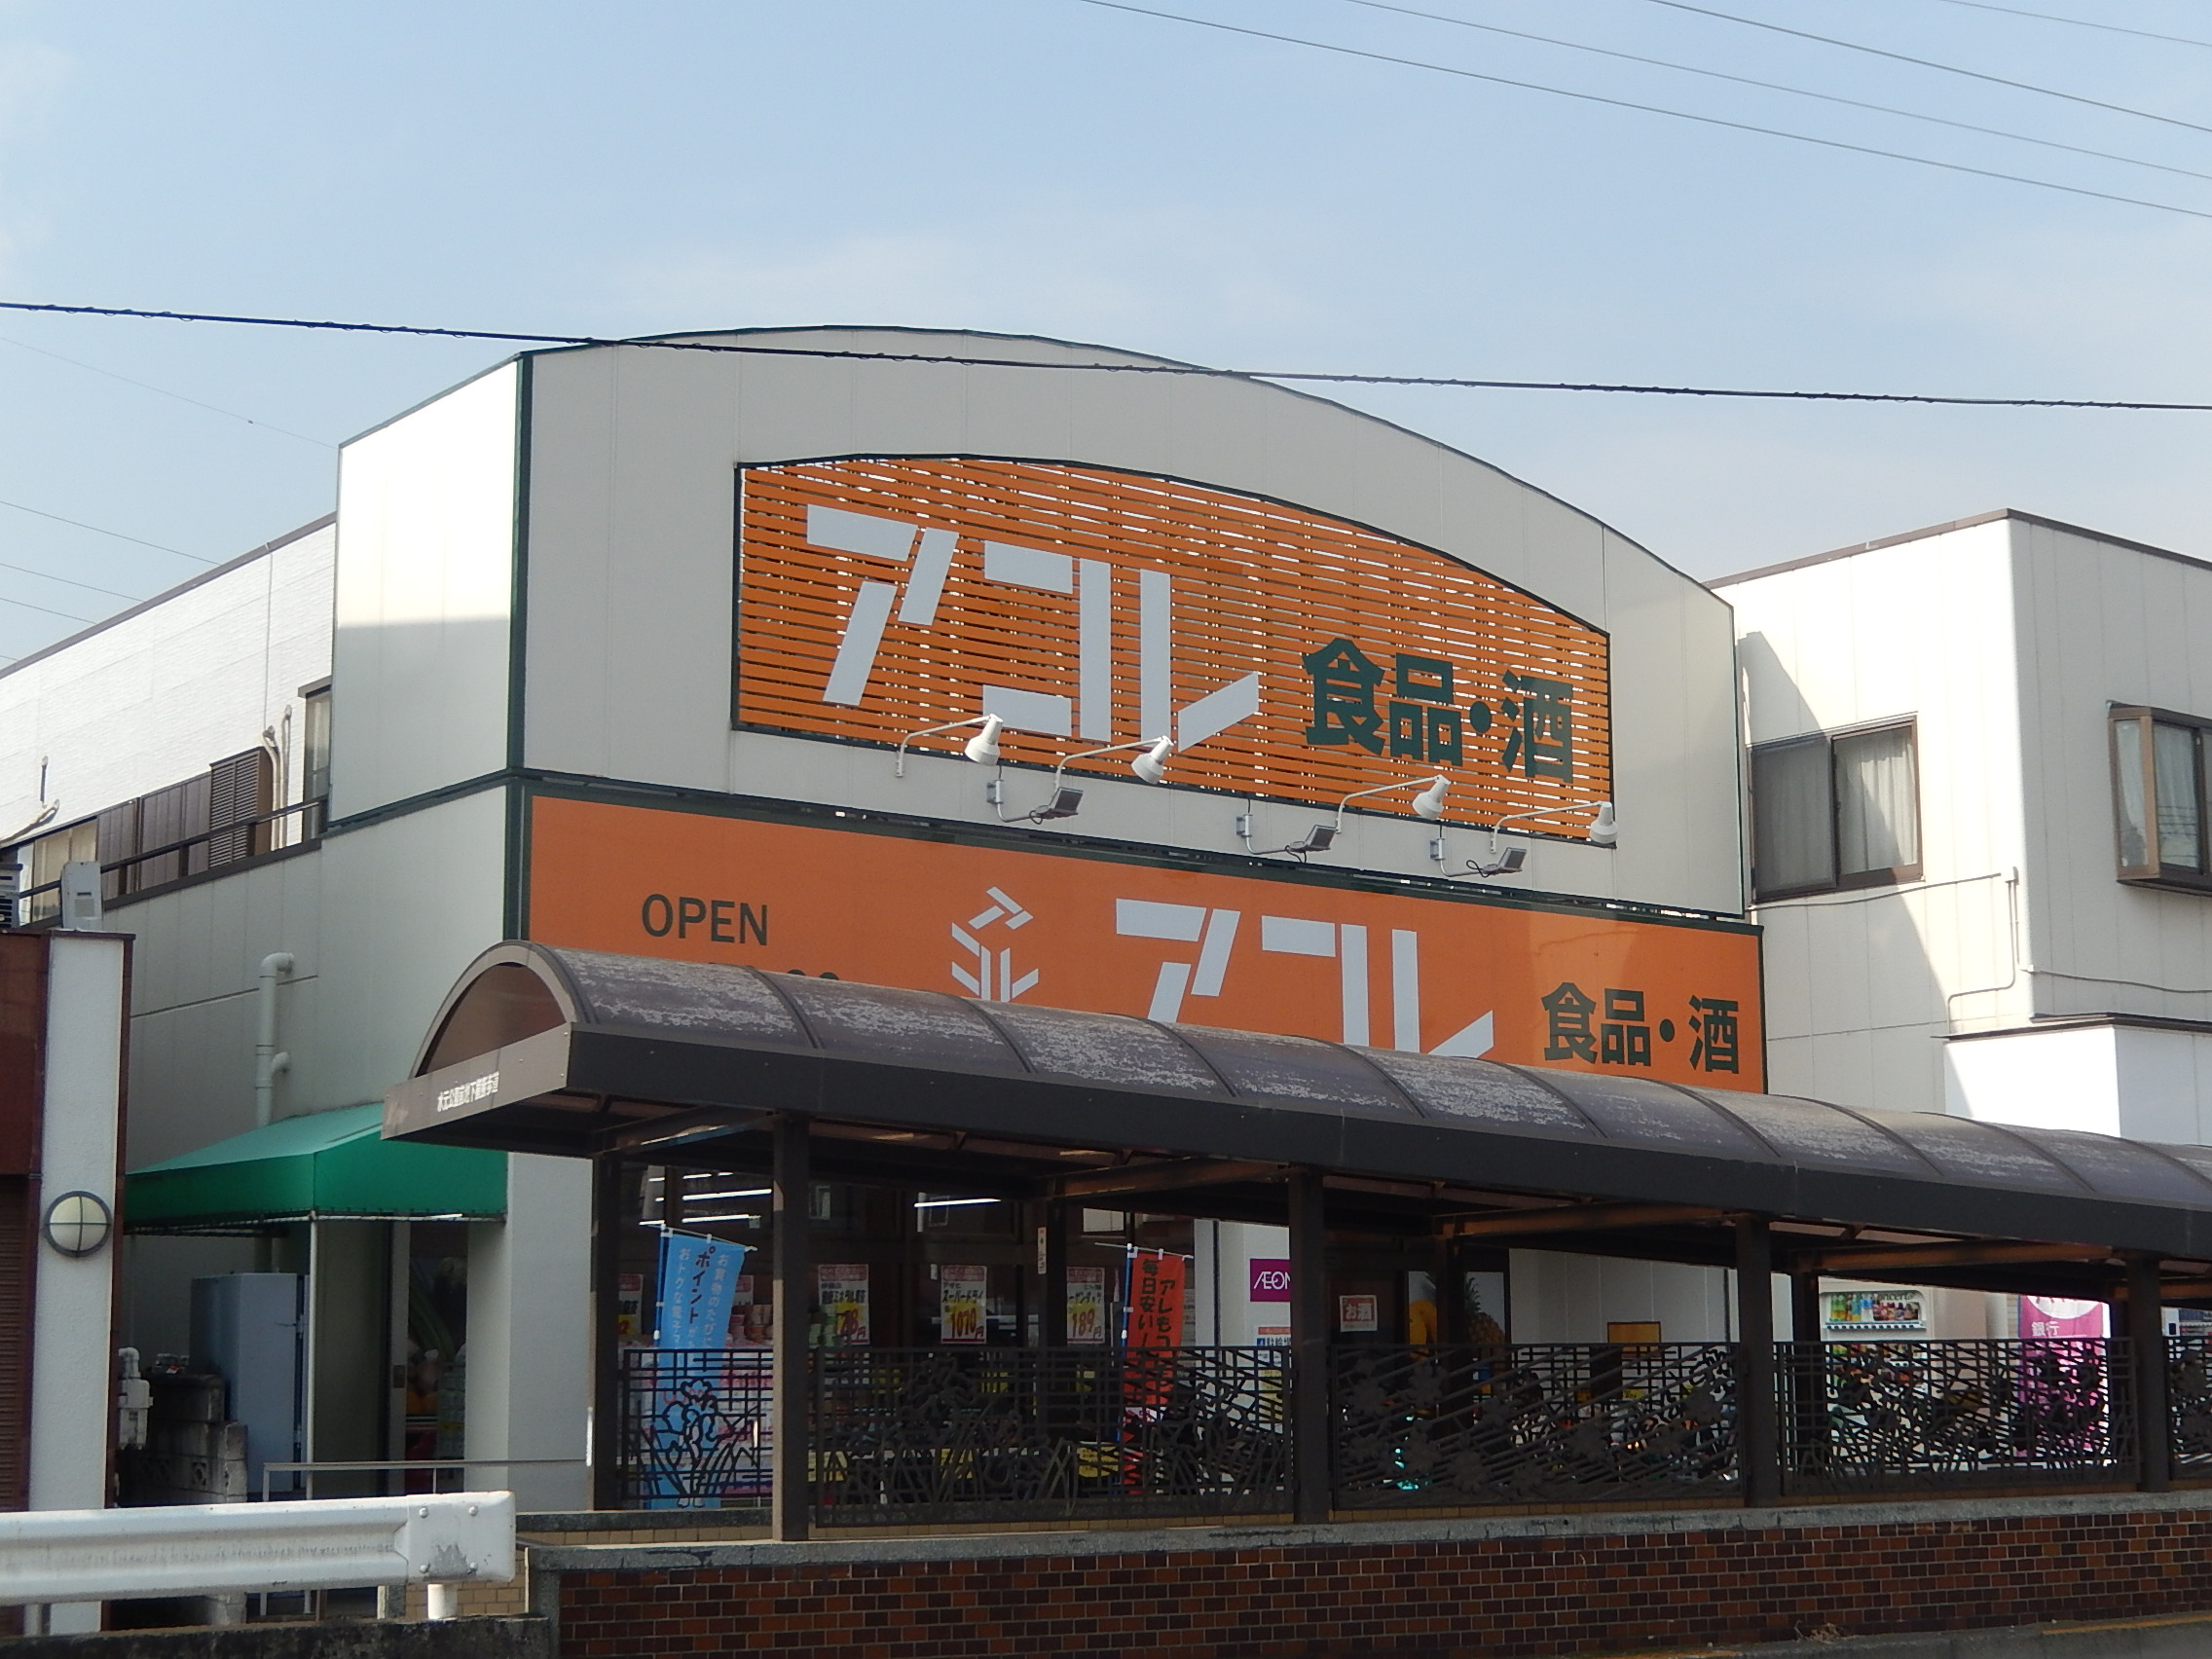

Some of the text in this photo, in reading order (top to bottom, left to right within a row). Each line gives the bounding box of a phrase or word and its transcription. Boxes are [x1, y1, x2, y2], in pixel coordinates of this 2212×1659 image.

[807, 503, 1260, 754] アコレ
[1302, 637, 1574, 784] 食品・酒
[642, 894, 768, 946] OPEN
[1540, 981, 1740, 1075] 食品・酒
[1346, 1303, 1373, 1321] お酒
[2031, 1320, 2061, 1337] 銀行
